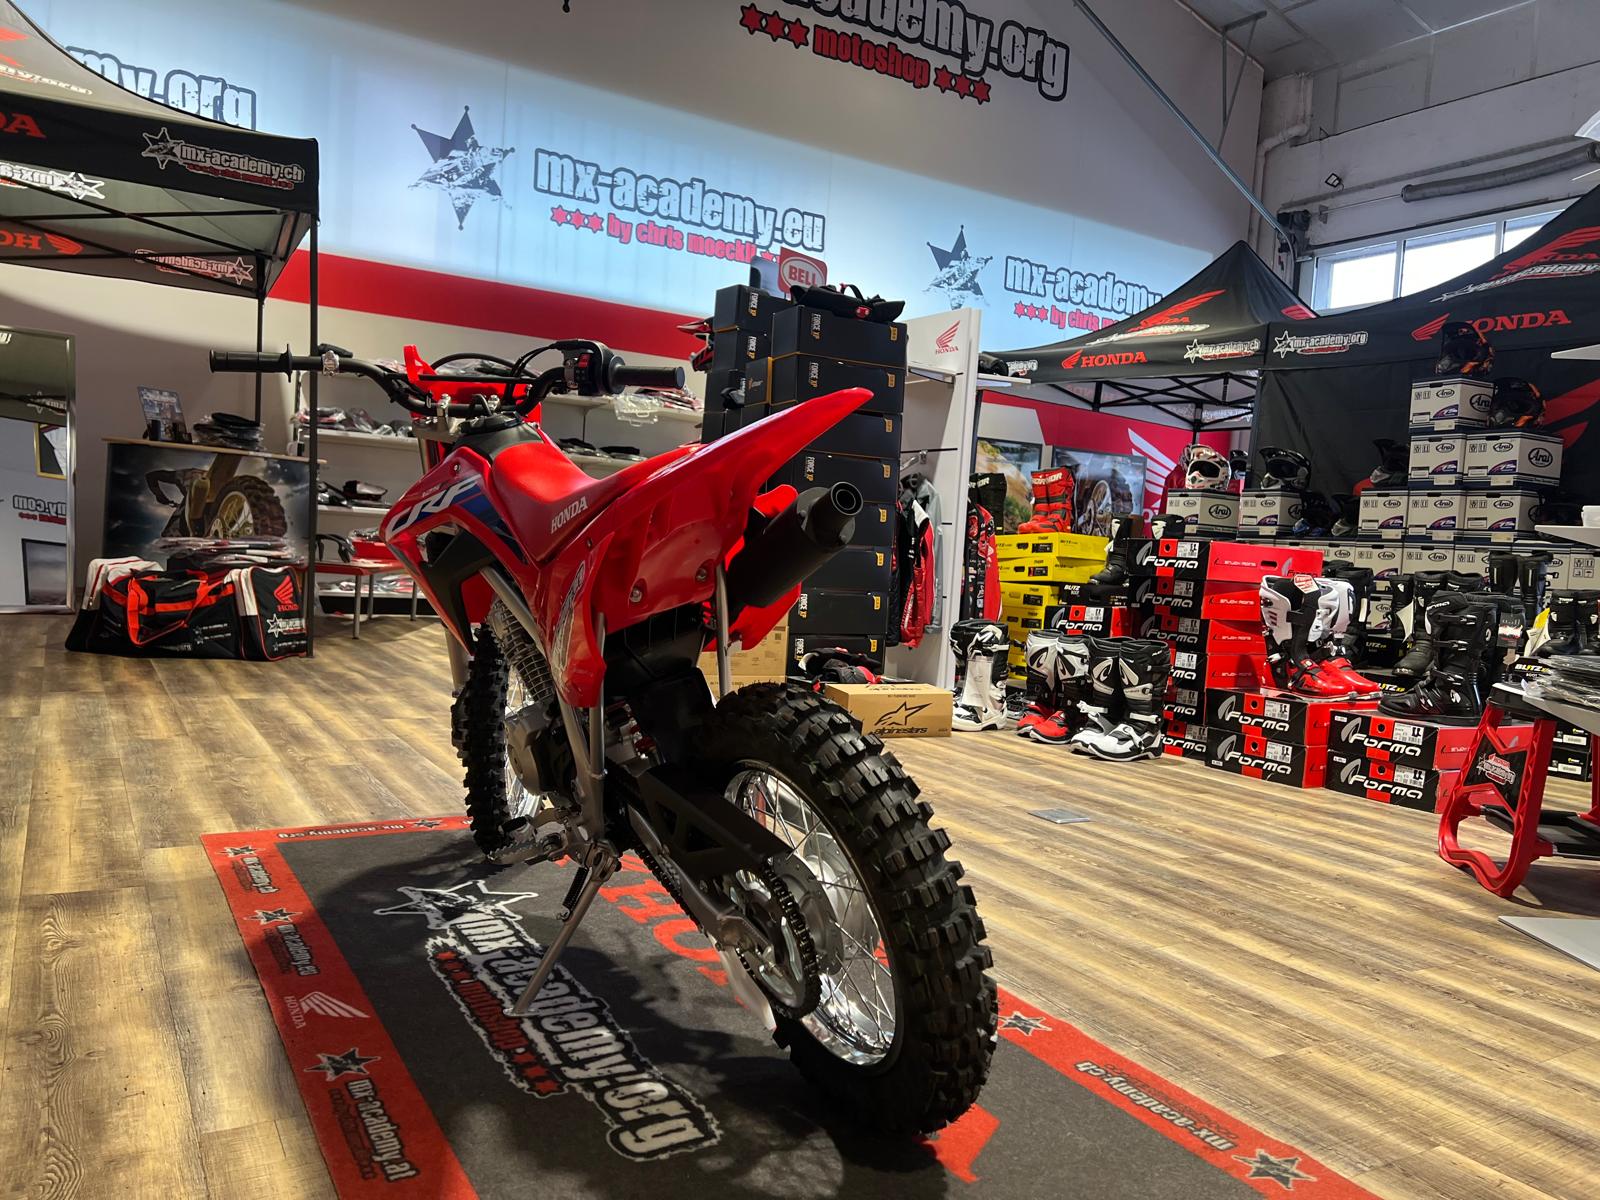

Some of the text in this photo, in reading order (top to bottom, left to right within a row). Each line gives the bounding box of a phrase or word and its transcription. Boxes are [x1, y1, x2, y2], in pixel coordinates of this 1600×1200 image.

[812, 24, 931, 89] motoshop
[179, 142, 306, 183] mx-academy.ch
[534, 148, 826, 252] mx-academy.eu
[607, 212, 633, 244] by
[636, 219, 685, 251] chris
[788, 265, 817, 288] BELL
[750, 292, 758, 309] FORCE
[812, 313, 821, 330] FORCE
[1050, 304, 1067, 330] by
[1068, 308, 1100, 332] chris
[1466, 310, 1572, 333] ONDA
[748, 335, 757, 352] FORCE
[1200, 339, 1260, 354] mx-academy.ch
[1293, 331, 1368, 348] mx-academy.org
[935, 346, 959, 354] HONDA
[810, 362, 818, 378] FORCE
[1081, 352, 1147, 369] HONDA
[806, 456, 816, 472] FORCE
[551, 496, 588, 534] HONDA
[1143, 555, 1199, 569] Forma
[800, 593, 808, 610] FORCE
[1142, 593, 1193, 608] Forma
[1056, 620, 1103, 631] Forma
[1146, 628, 1198, 644] Forma
[1514, 663, 1542, 672] BLITZ
[1225, 711, 1290, 732] Forma
[1348, 733, 1421, 757] Forma
[1224, 751, 1292, 775] Forma
[1348, 774, 1423, 799] Forma
[284, 995, 307, 1029] HONDA
[1075, 1060, 1237, 1151] mx-academy.ch
[347, 1079, 418, 1181] mx-academy.at
